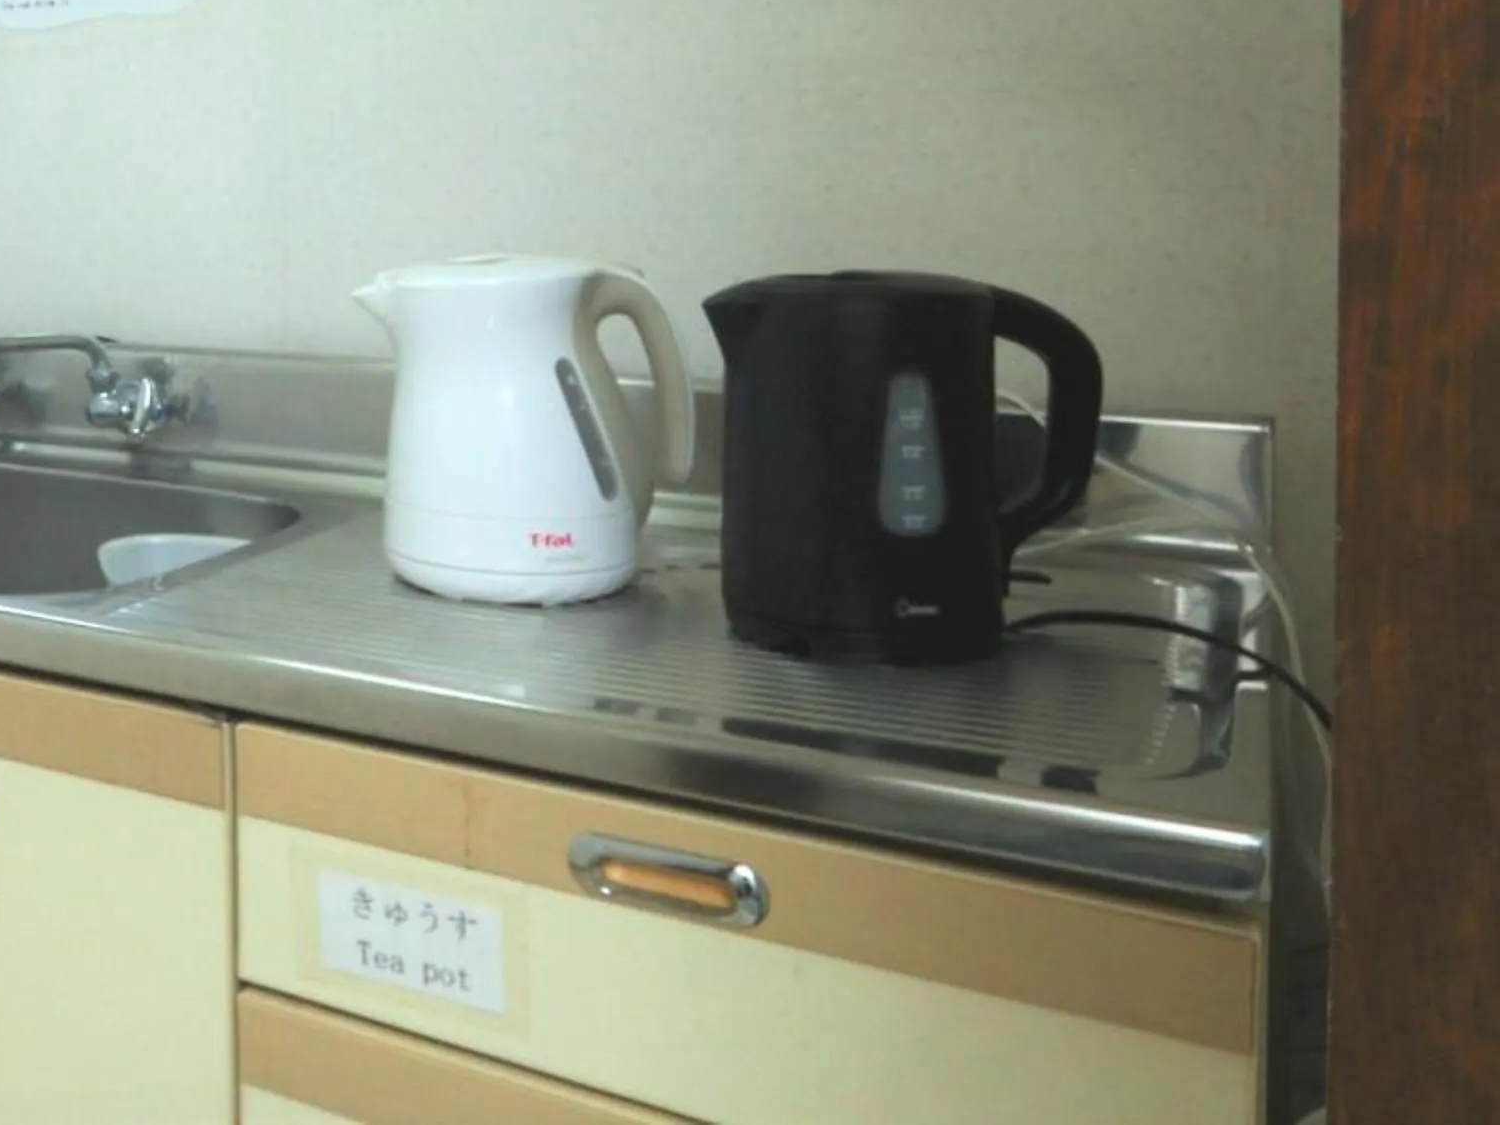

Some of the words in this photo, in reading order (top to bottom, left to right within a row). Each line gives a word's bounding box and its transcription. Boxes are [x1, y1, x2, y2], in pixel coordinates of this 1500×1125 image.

[352, 887, 478, 942] きゅうす
[356, 939, 404, 974] Tea
[423, 962, 472, 992] pot
